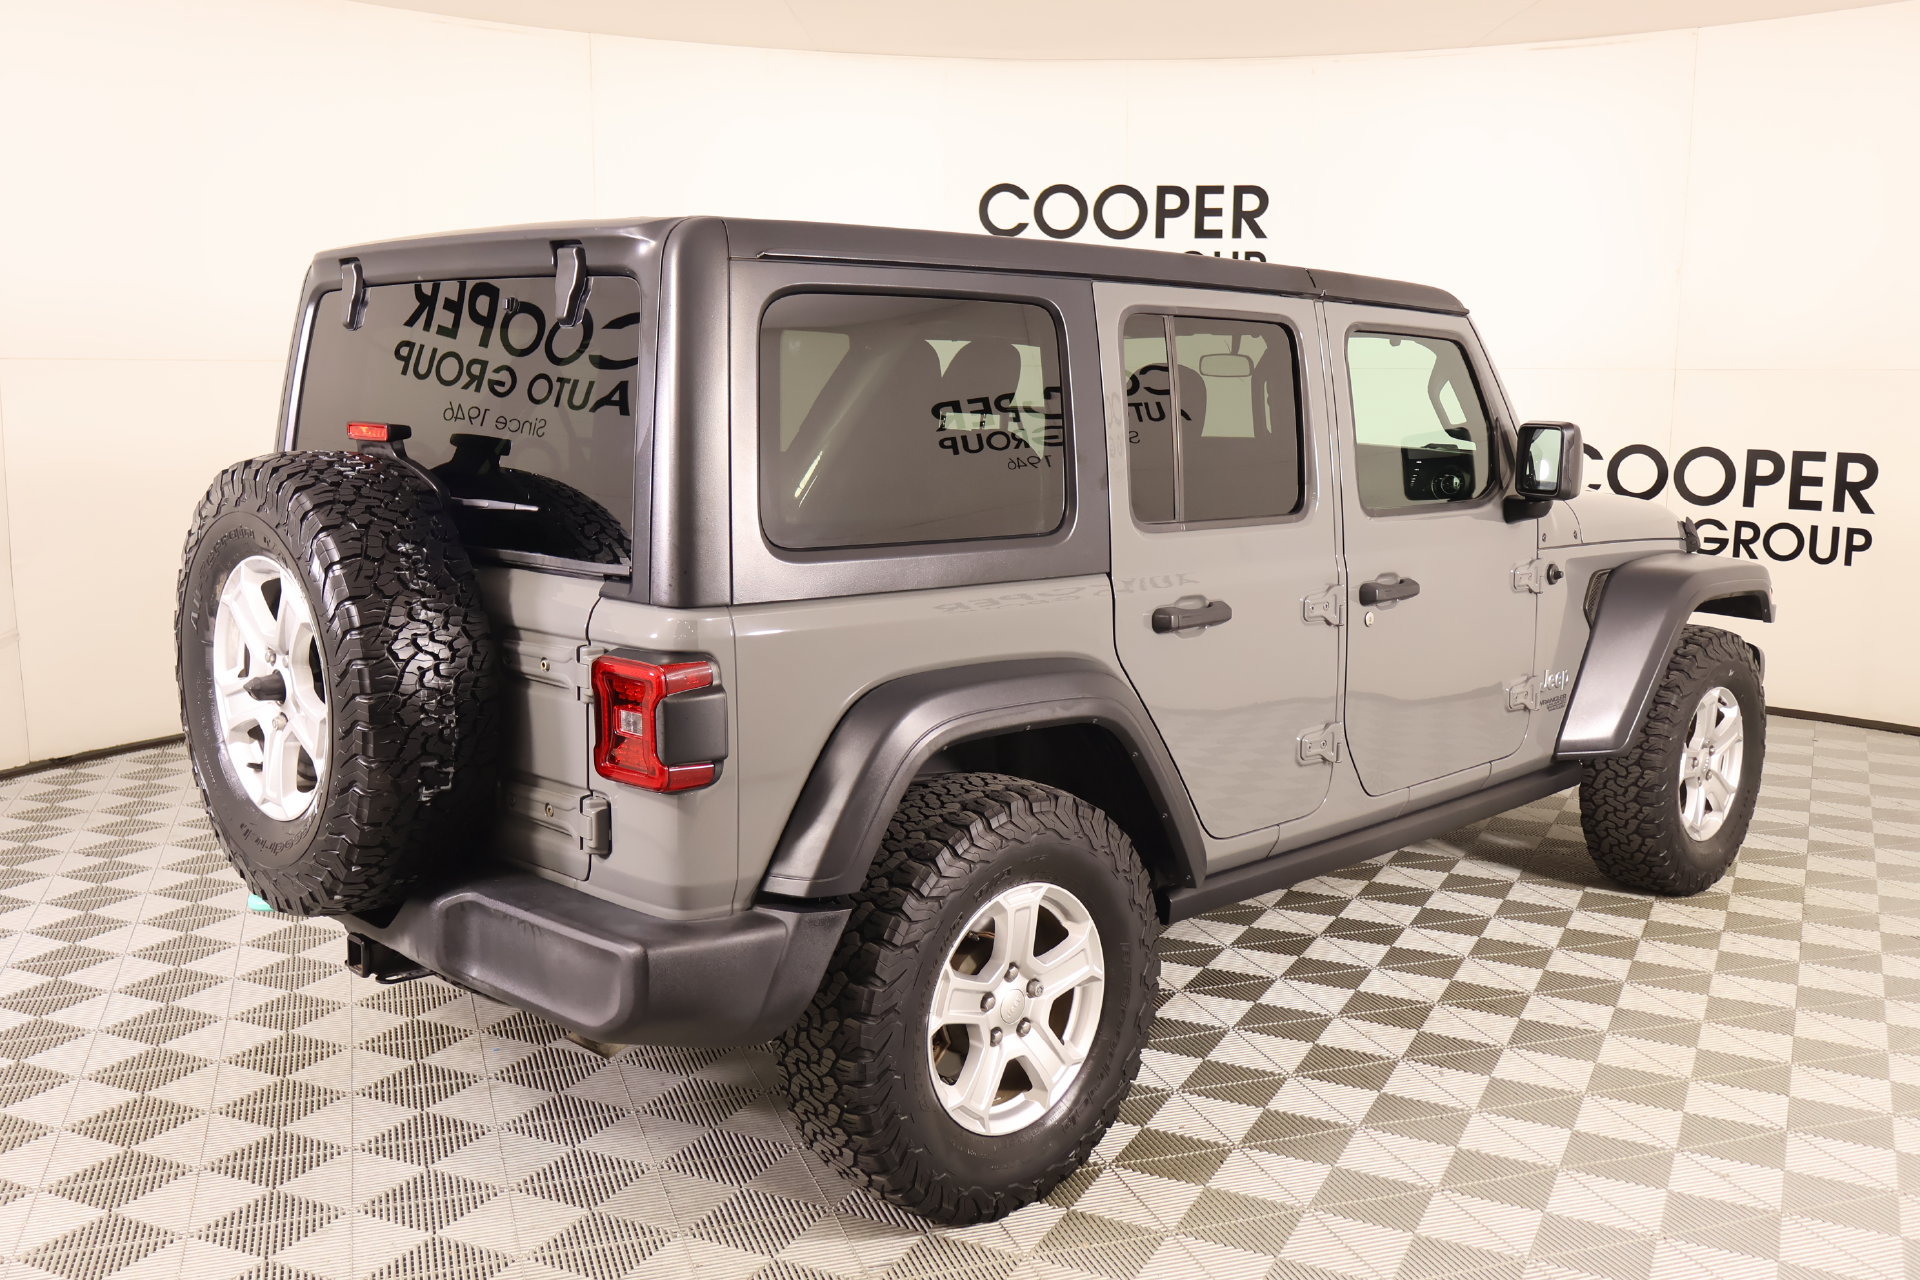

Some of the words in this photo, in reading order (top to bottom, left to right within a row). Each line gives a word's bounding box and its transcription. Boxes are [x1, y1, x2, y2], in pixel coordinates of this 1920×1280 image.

[979, 182, 1269, 240] COOPER
[1694, 518, 1873, 566] GROUP
[1540, 669, 1569, 691] Jeep
